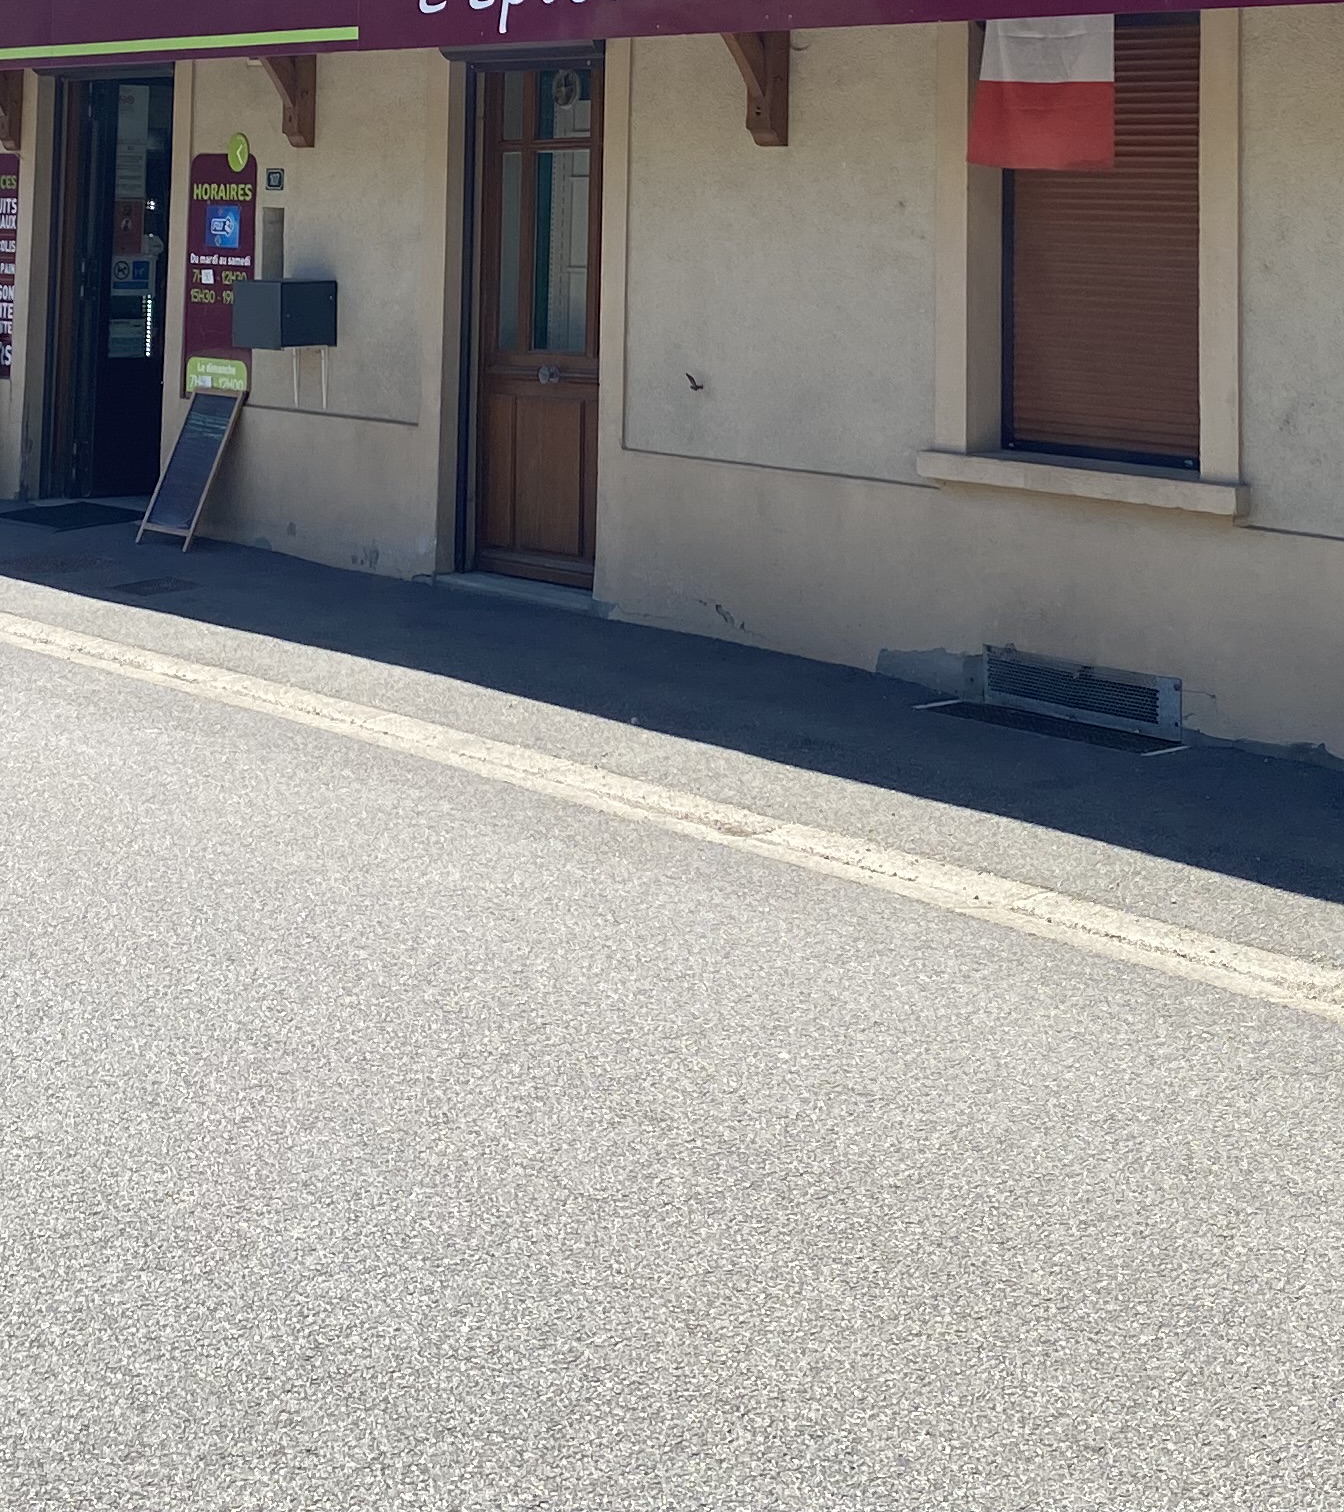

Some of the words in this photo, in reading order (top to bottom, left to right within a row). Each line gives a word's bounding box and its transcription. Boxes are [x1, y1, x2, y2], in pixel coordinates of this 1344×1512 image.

[193, 183, 253, 200] HORAIRES
[200, 254, 218, 265] mardi
[227, 255, 251, 266] samedi
